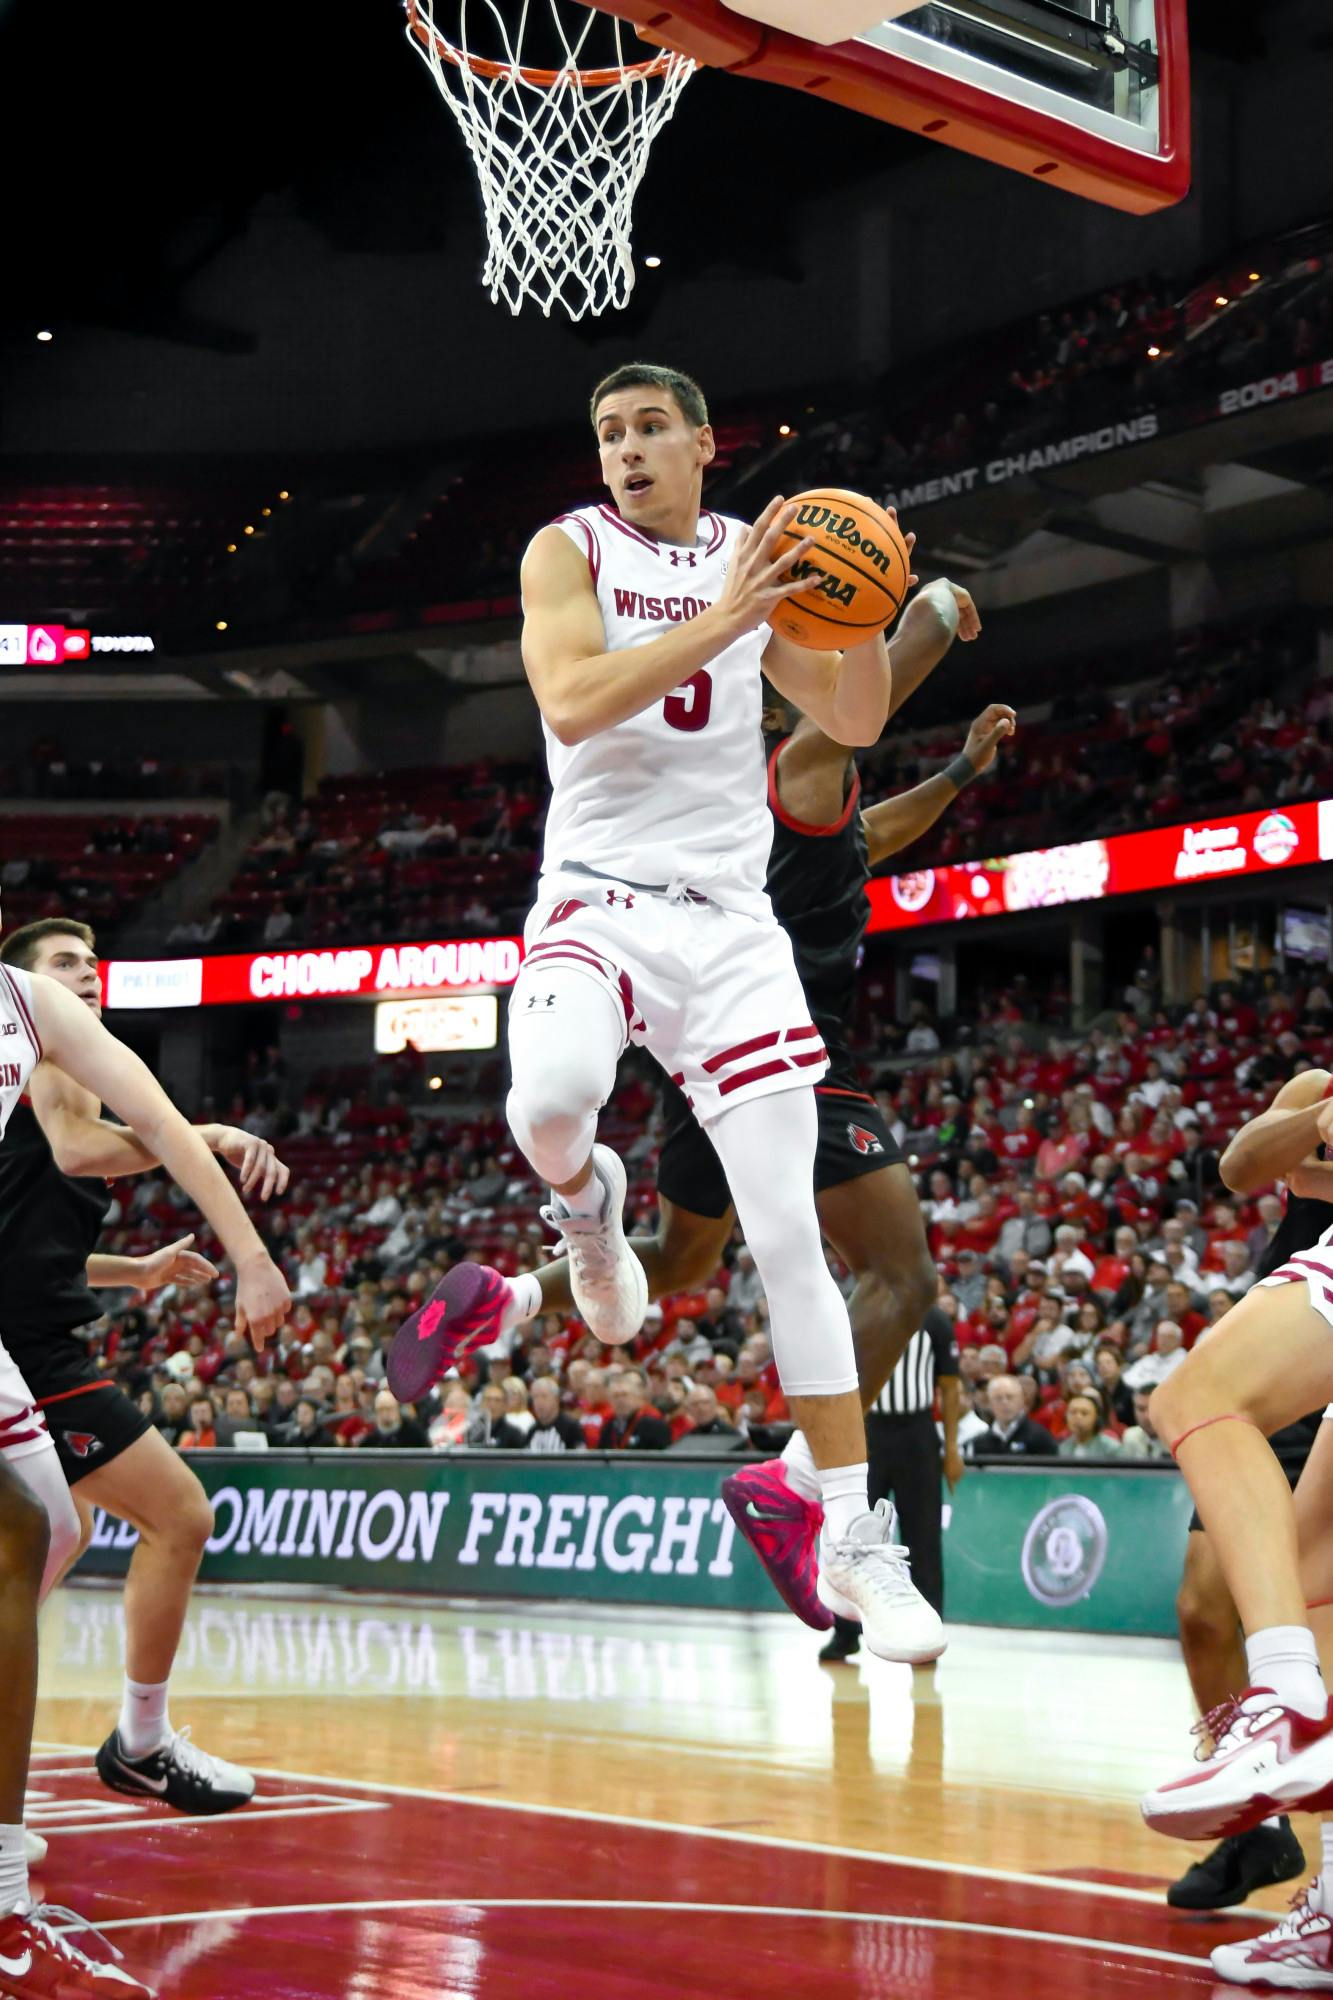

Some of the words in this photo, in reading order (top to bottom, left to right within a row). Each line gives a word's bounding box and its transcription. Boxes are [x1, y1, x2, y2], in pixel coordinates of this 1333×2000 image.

[1219, 370, 1298, 414] 2004
[879, 468, 979, 510] AMENT
[985, 414, 1159, 484] CHAMPIONS
[796, 504, 891, 577] Wilson
[91, 636, 155, 652] TOYOTA
[249, 947, 374, 998] CHOMP
[375, 940, 521, 989] AROUND
[204, 1487, 450, 1562] OMINION
[457, 1493, 737, 1577] FREIGHT
